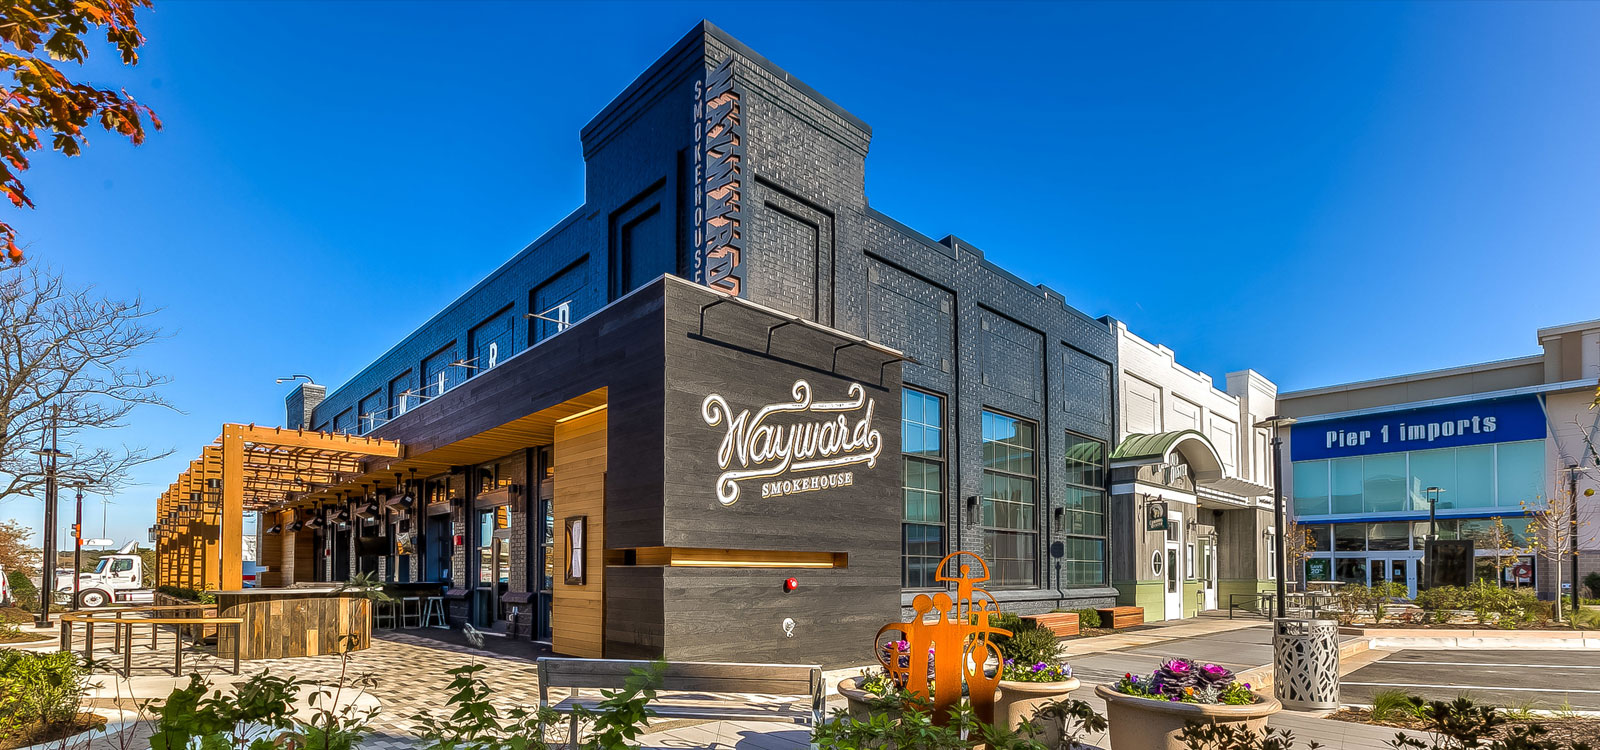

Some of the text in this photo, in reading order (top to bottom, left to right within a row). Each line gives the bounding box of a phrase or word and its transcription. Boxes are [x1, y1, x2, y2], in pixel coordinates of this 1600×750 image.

[693, 79, 703, 283] SMOKEHOUSE
[702, 380, 882, 505] Wayward
[1326, 415, 1497, 448] Pier 1 imports
[761, 471, 854, 498] SMOKEHOUSE
